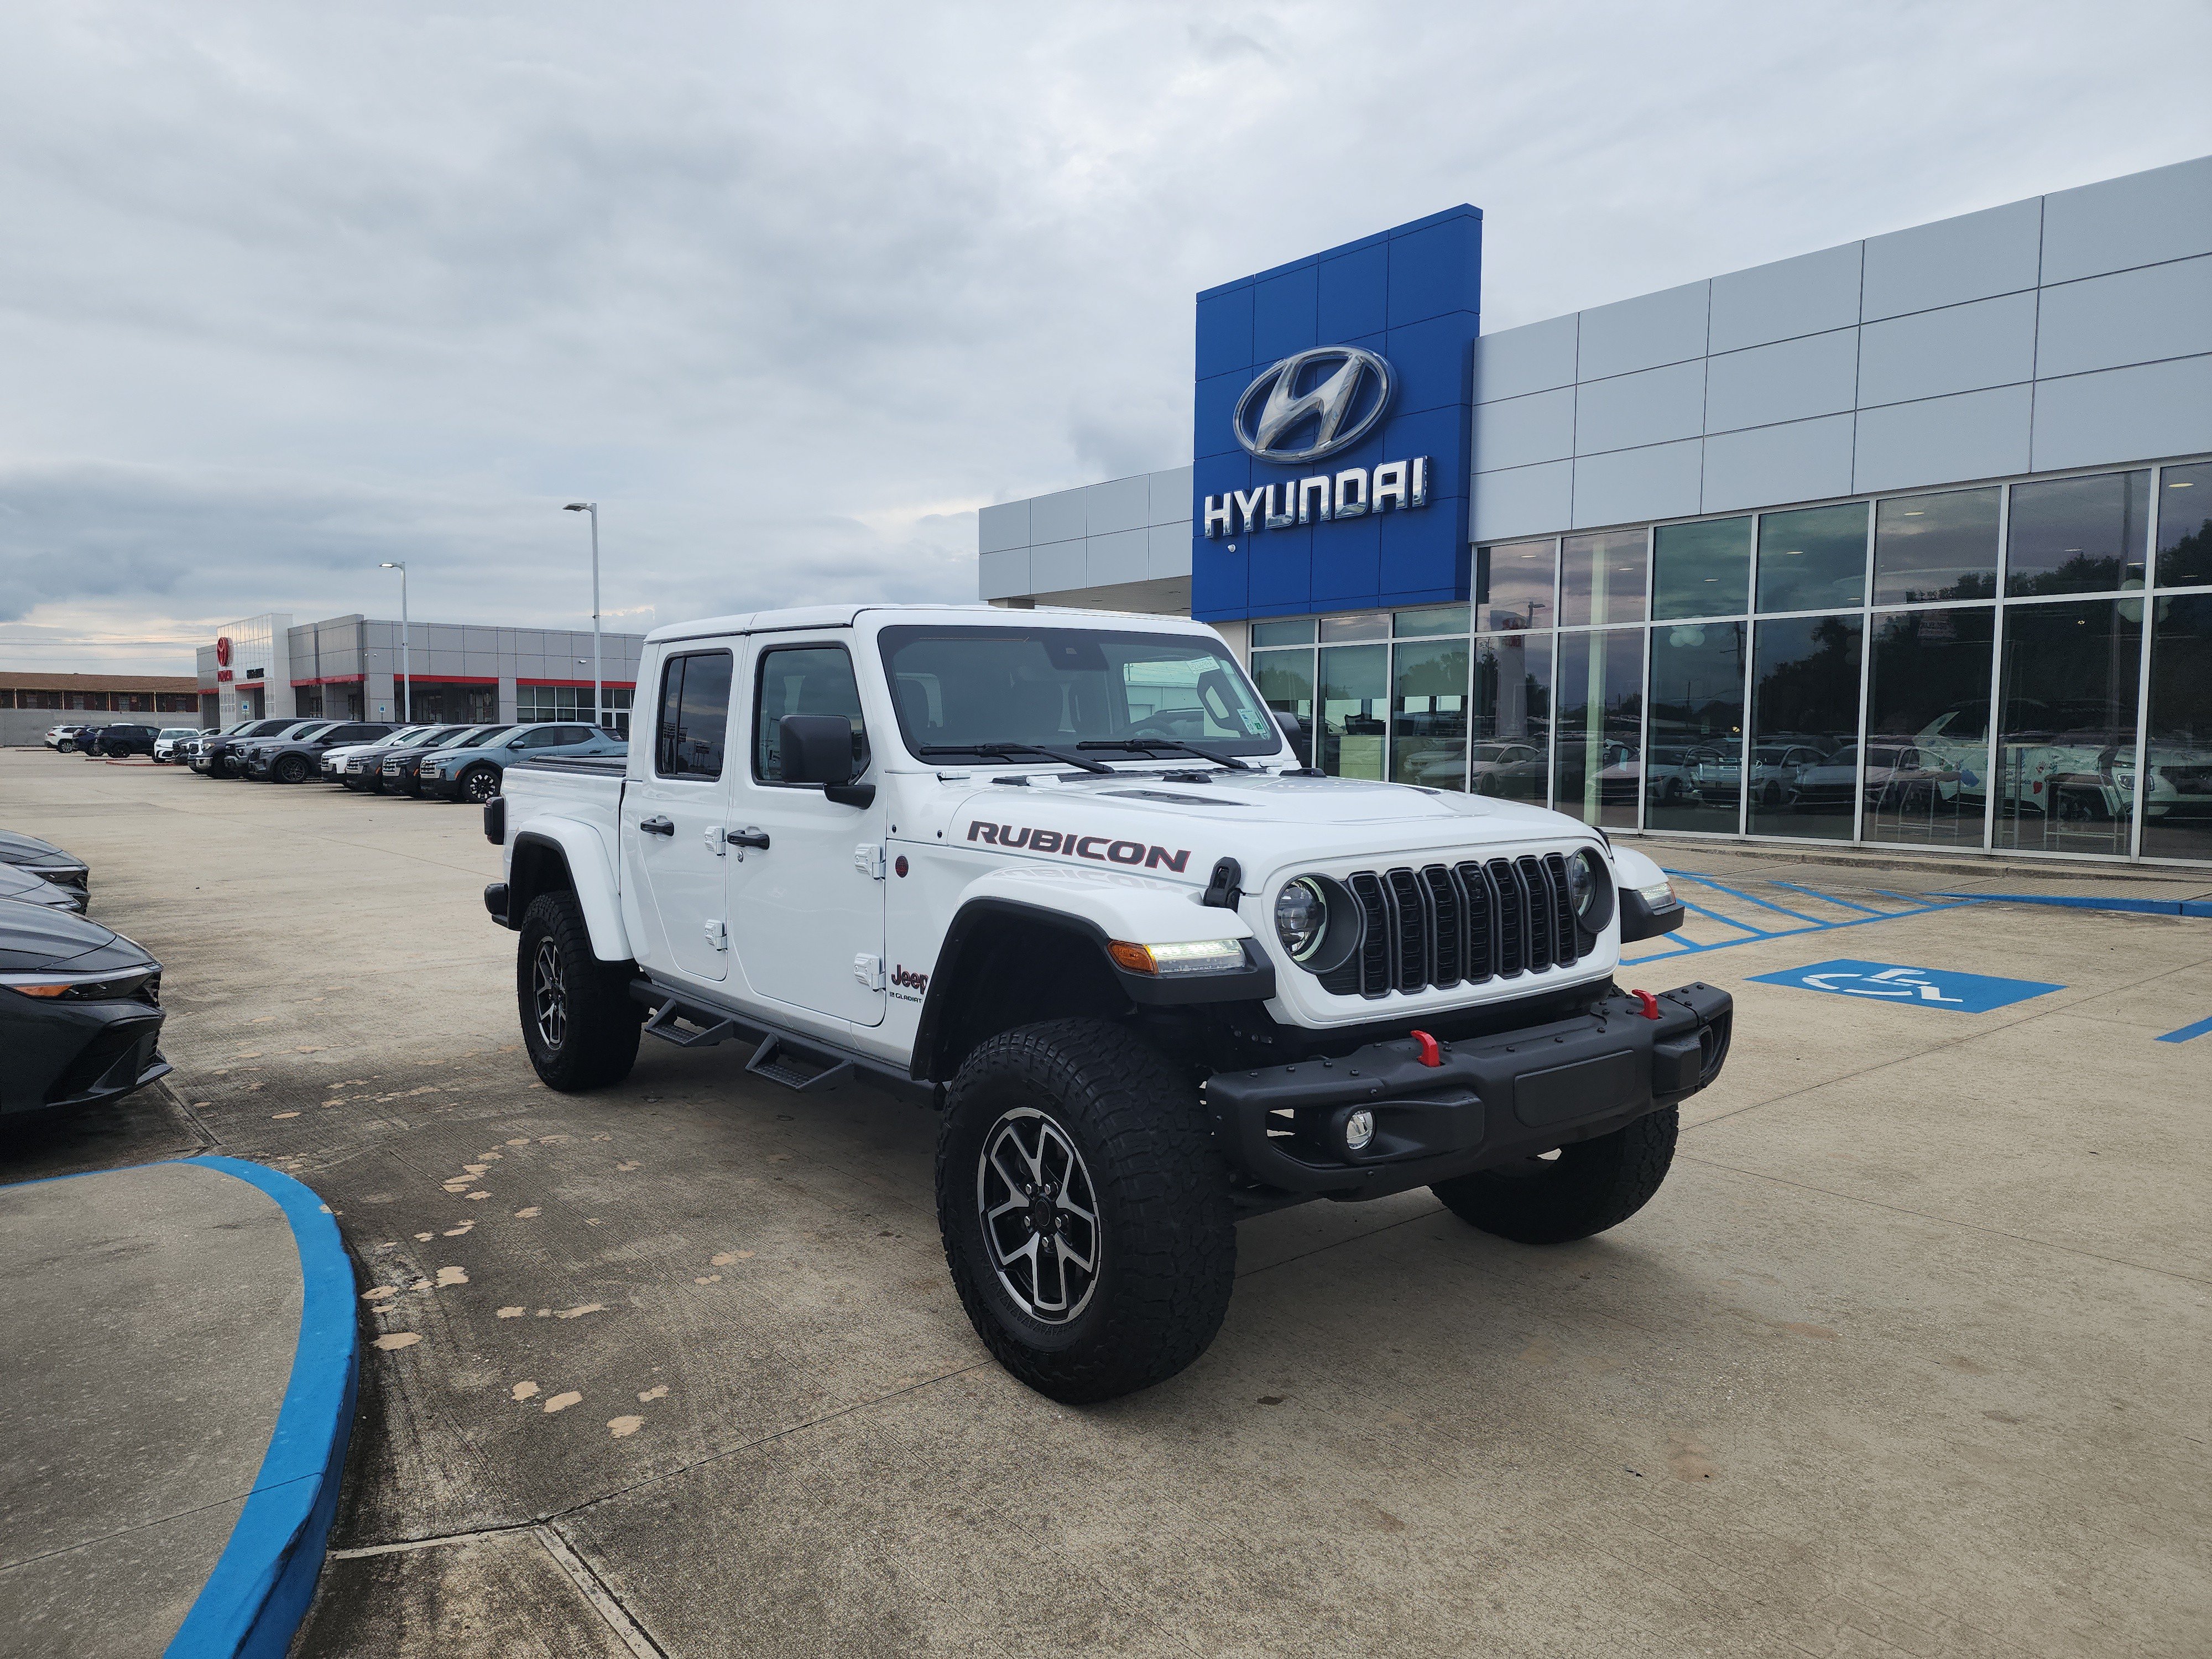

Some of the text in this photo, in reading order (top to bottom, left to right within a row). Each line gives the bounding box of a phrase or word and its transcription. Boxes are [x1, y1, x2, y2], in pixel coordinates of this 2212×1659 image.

[1204, 456, 1428, 539] HYUNDAI
[967, 820, 1192, 873] RUBICON
[891, 964, 929, 995] Jeep
[895, 993, 923, 1004] GLADIAT
